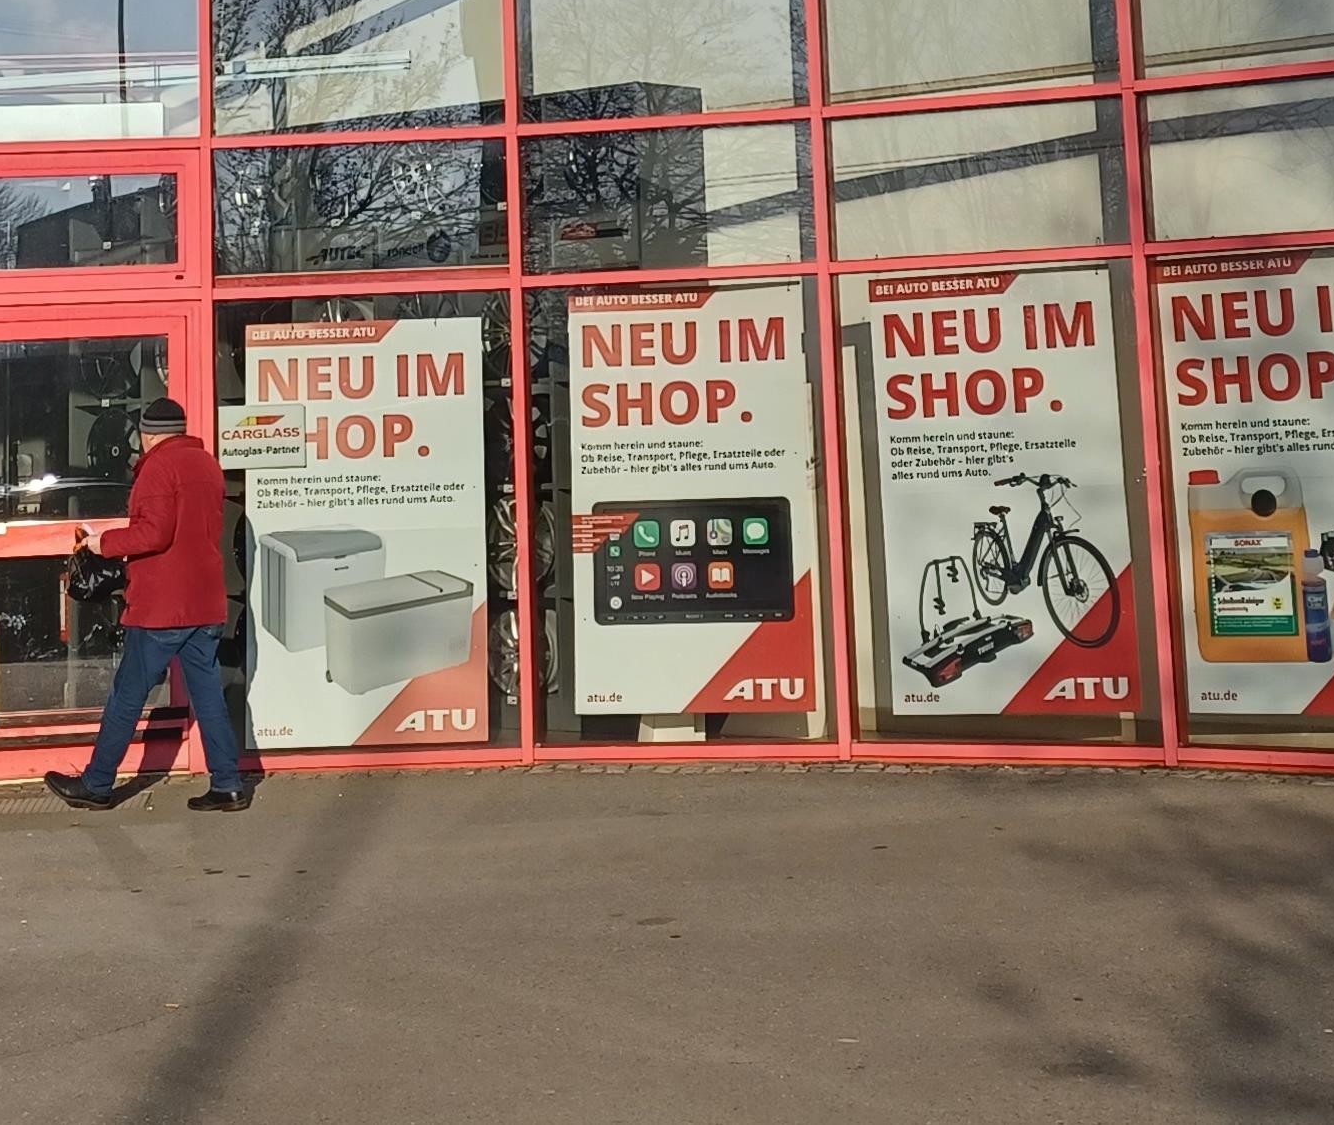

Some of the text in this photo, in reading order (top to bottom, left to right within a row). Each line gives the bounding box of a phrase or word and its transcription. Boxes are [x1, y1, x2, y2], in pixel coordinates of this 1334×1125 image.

[1163, 257, 1292, 277] BEI AUTO BESSER ATU
[875, 277, 1000, 296] BEI AUTO BESSER ATU
[575, 292, 698, 307] BEI AUTO BESSER ATU
[1171, 287, 1295, 343] NEU
[251, 327, 375, 341] BEI AUTO BESSER ATU
[883, 300, 1096, 359] NEU IM
[581, 317, 785, 369] NEU IM
[257, 351, 465, 403] NEU IM
[581, 379, 753, 428] SHOP.
[886, 367, 1063, 421] SHOP.
[221, 427, 301, 441] CARGLASS
[305, 413, 431, 461] HOP.
[221, 445, 301, 458] Autoglas-Partner
[586, 692, 623, 703] atu.de
[722, 677, 805, 701] ATU
[904, 691, 941, 703] atu.de
[1043, 677, 1129, 701] ATU
[1200, 690, 1238, 701] atu.de
[256, 726, 293, 737] atu.de
[394, 708, 476, 733] ATU
